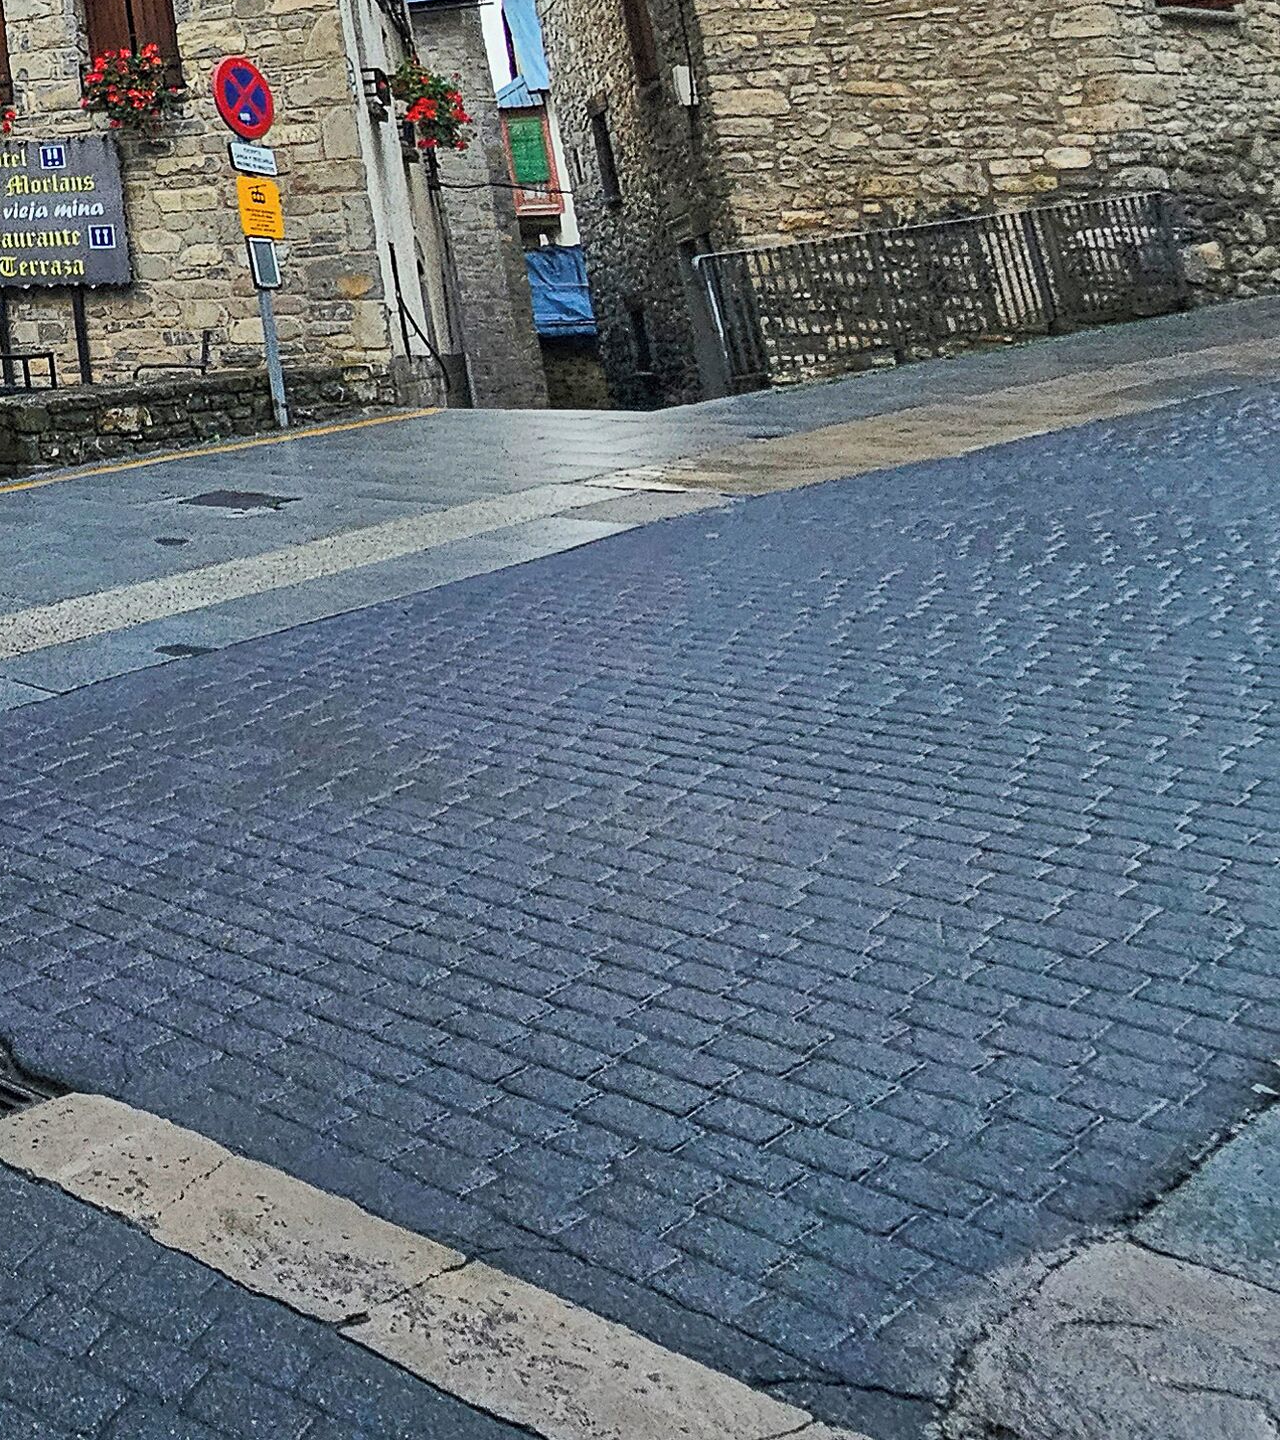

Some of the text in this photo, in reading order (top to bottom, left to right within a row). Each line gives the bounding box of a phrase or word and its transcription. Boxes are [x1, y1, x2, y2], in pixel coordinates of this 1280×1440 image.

[4, 173, 96, 198] Morlans
[3, 202, 49, 222] vieja
[54, 198, 105, 219] mina
